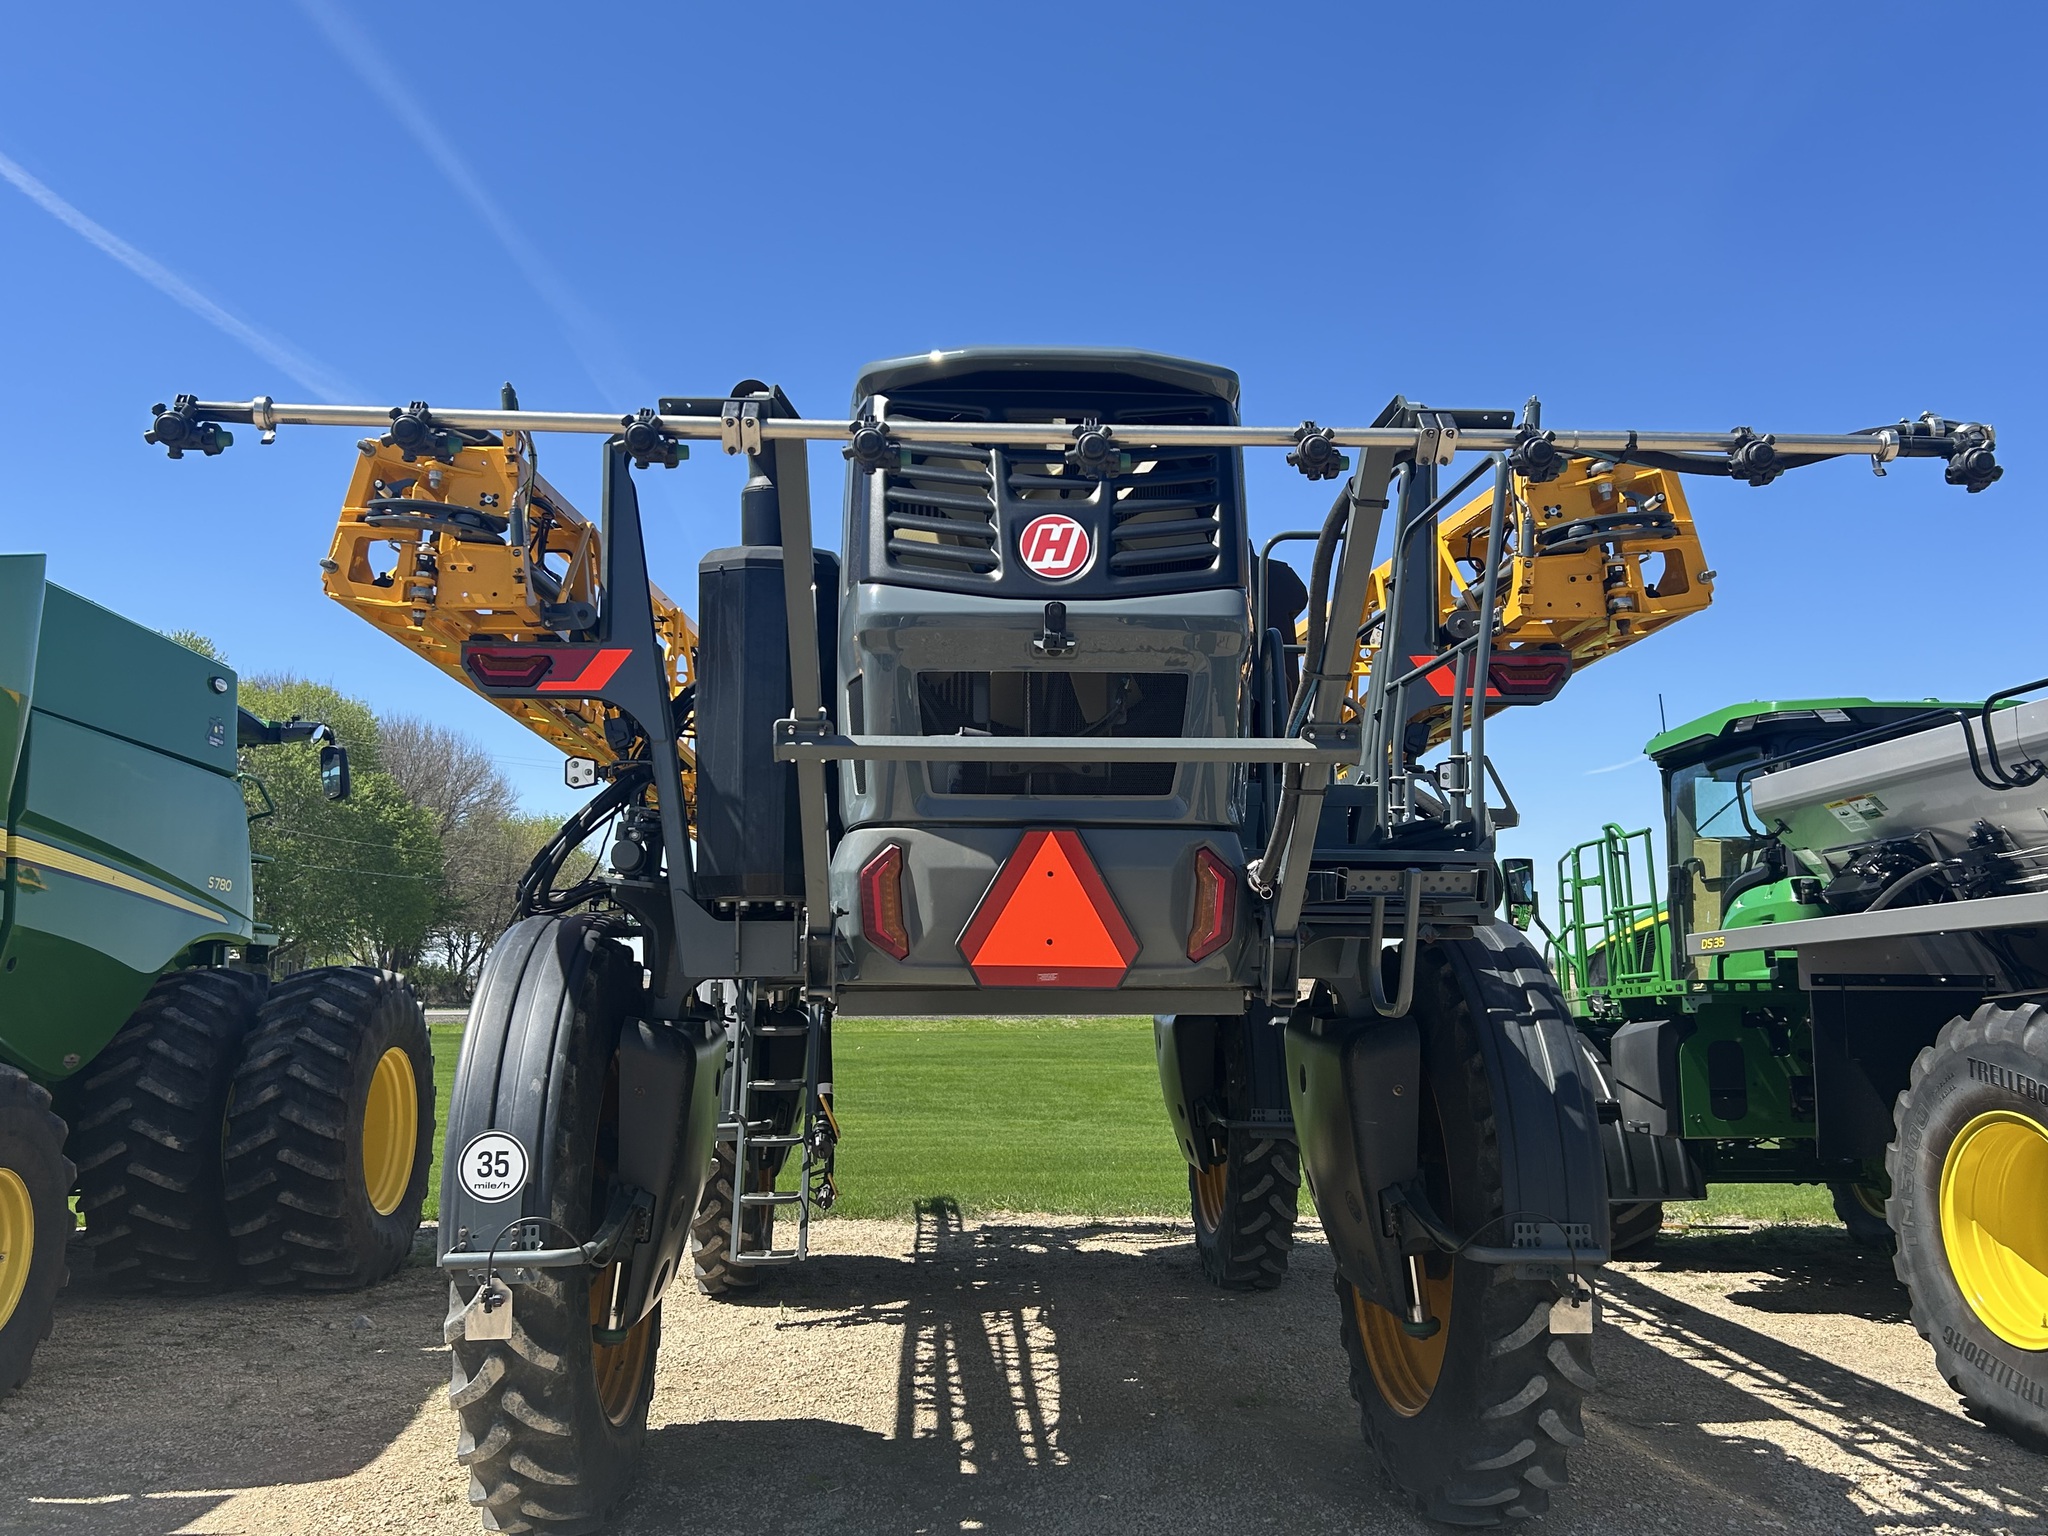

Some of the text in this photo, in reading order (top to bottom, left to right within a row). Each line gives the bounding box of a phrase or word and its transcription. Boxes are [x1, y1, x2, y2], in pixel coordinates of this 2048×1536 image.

[208, 876, 232, 891] S780
[477, 1151, 510, 1178] 35
[474, 1182, 511, 1190] mile/h
[1942, 1325, 2047, 1410] TRELLEBORG
